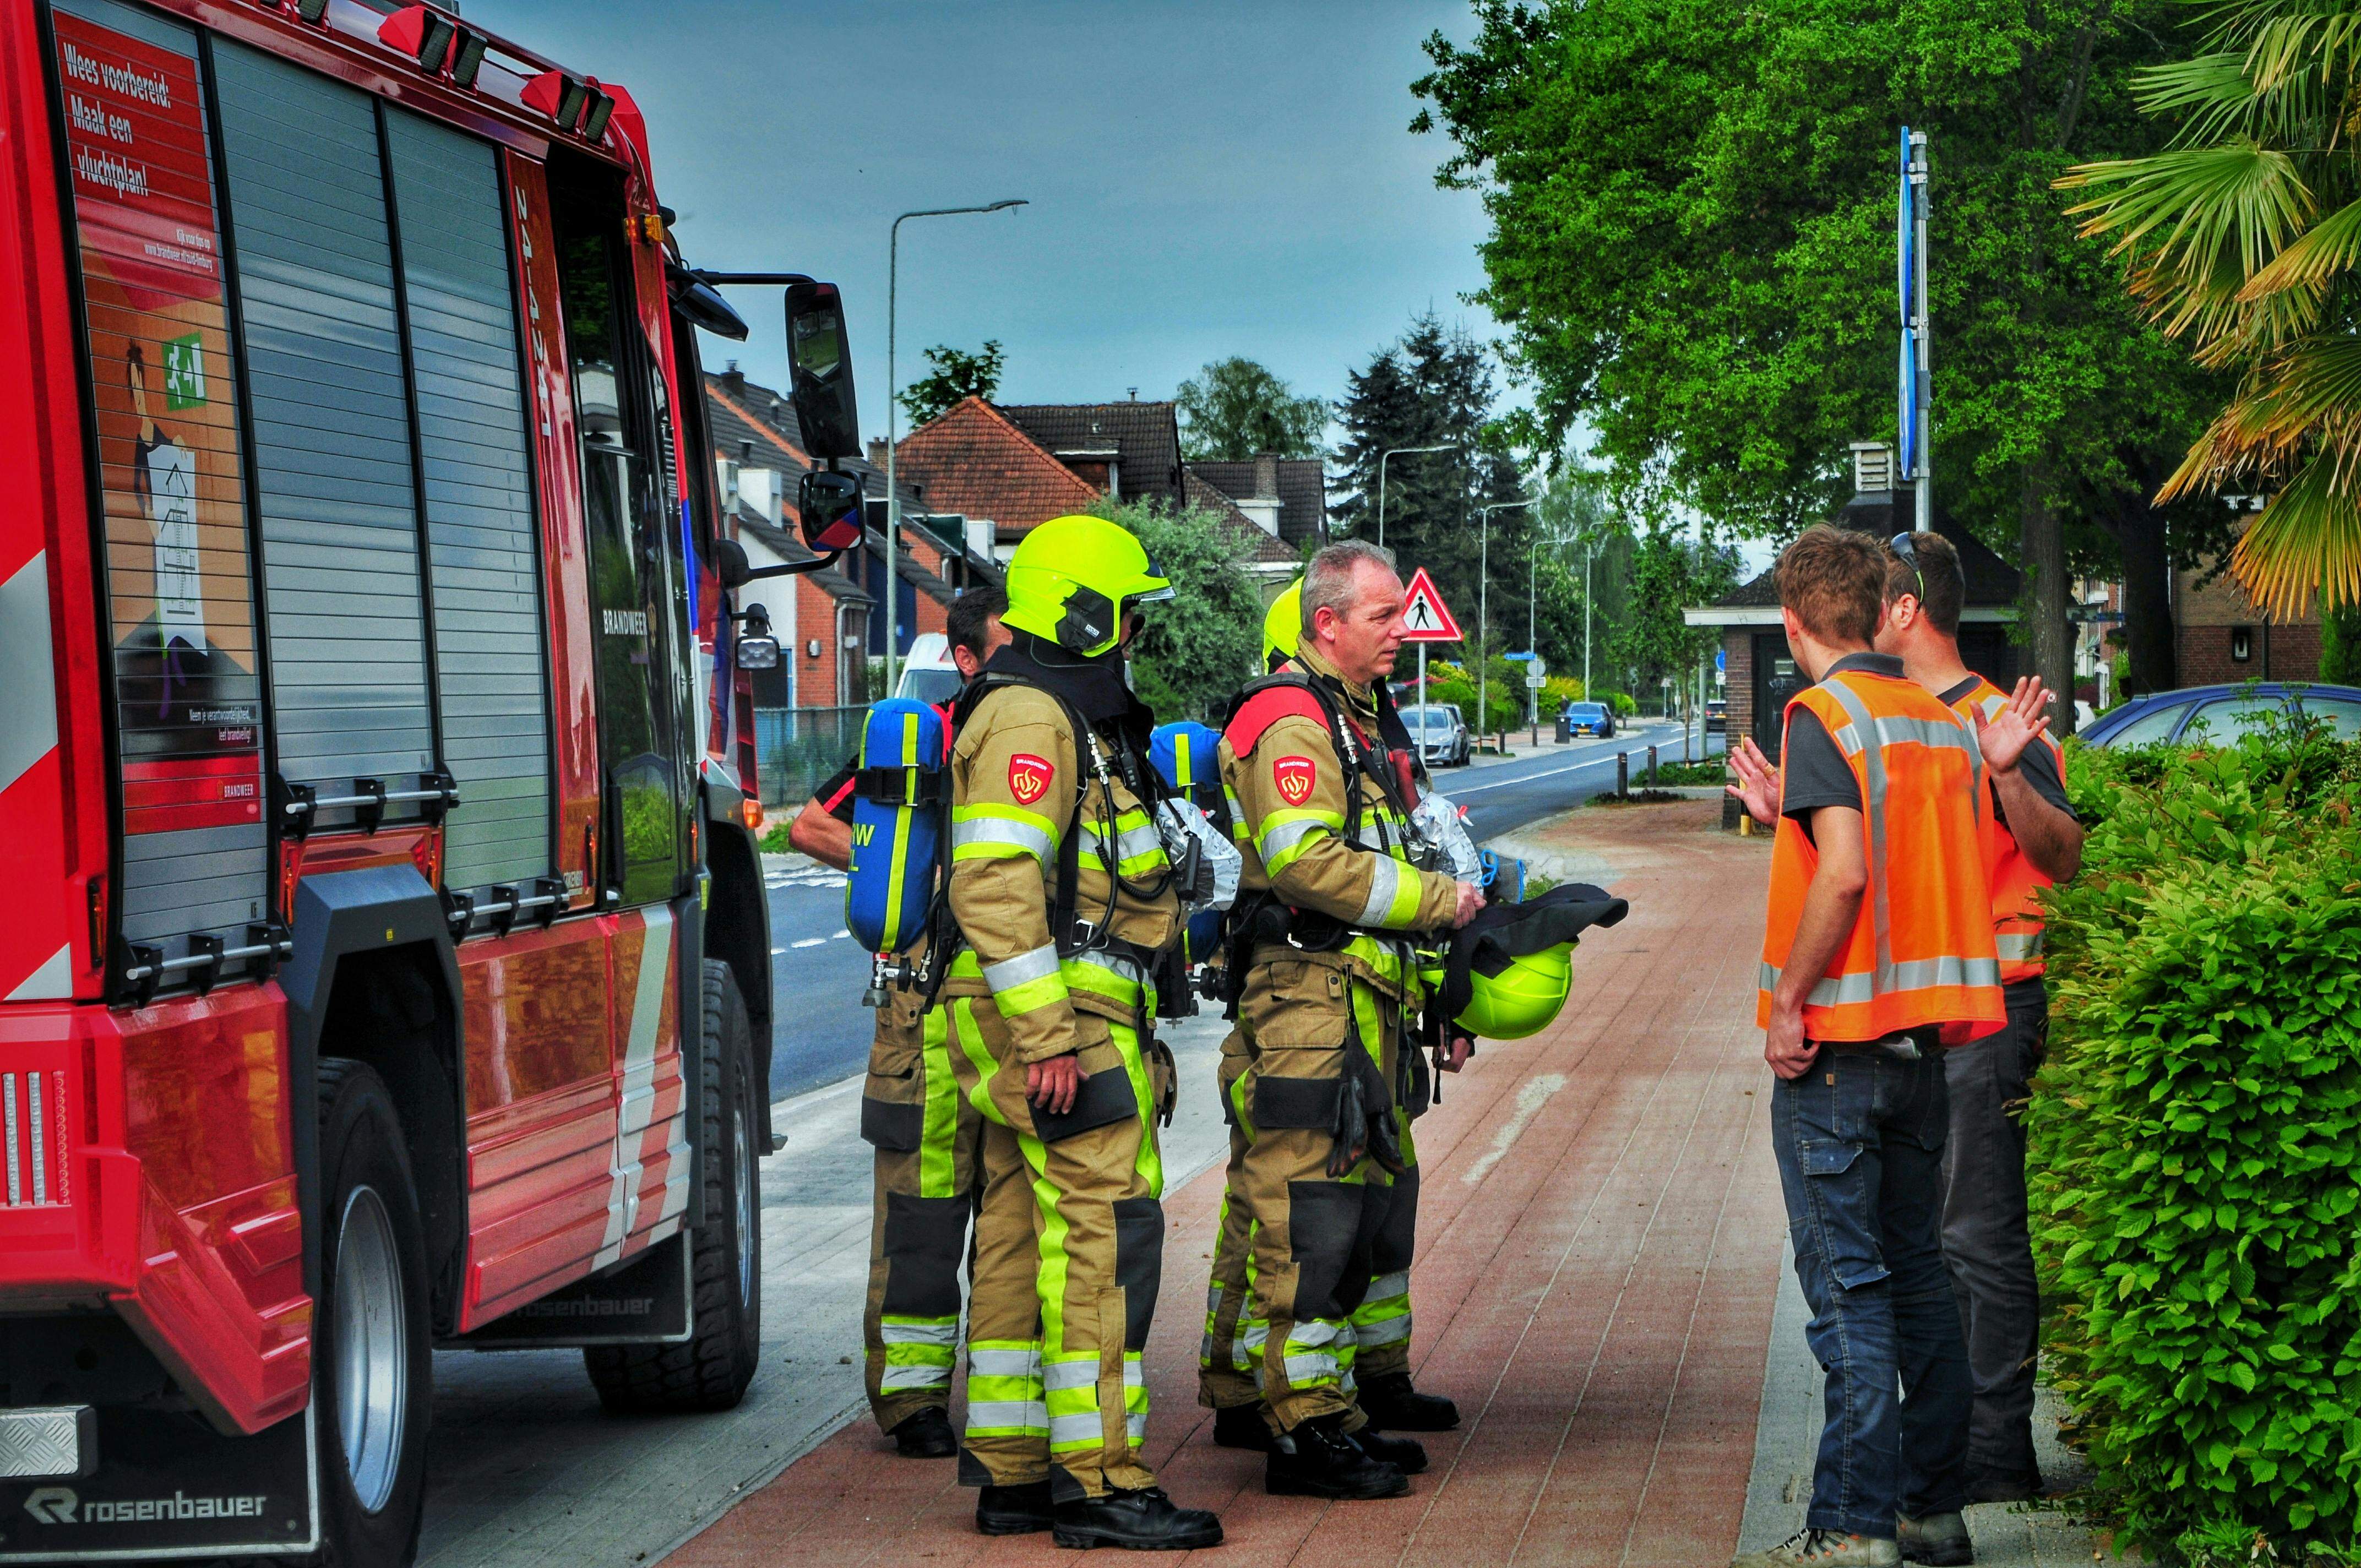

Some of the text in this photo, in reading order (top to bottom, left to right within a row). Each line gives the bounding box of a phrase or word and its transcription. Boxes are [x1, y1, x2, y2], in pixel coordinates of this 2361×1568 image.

[63, 42, 171, 109] Wees voorbereid:
[70, 94, 133, 144] Maak een
[77, 145, 148, 199] vluchtplan!
[603, 608, 648, 635] BRANDWEER
[224, 783, 253, 798] BRANDWEER
[84, 1490, 268, 1523] rosenbauer
